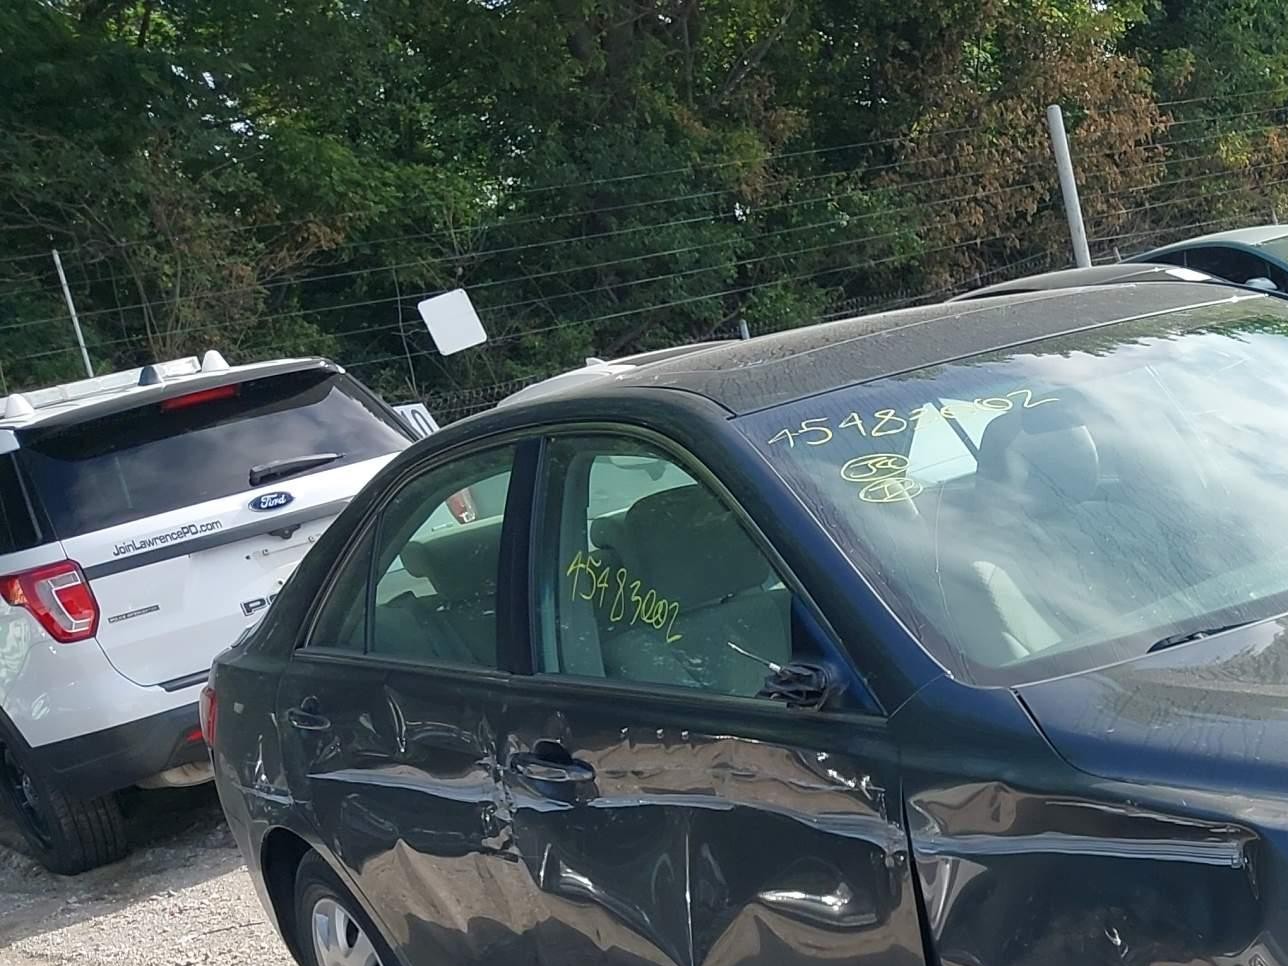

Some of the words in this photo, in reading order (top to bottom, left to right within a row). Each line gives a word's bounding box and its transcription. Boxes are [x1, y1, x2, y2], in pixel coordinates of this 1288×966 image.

[260, 493, 287, 509] Ford
[112, 519, 223, 557] JoinLawrencePD.com
[566, 551, 683, 644] 45483002
